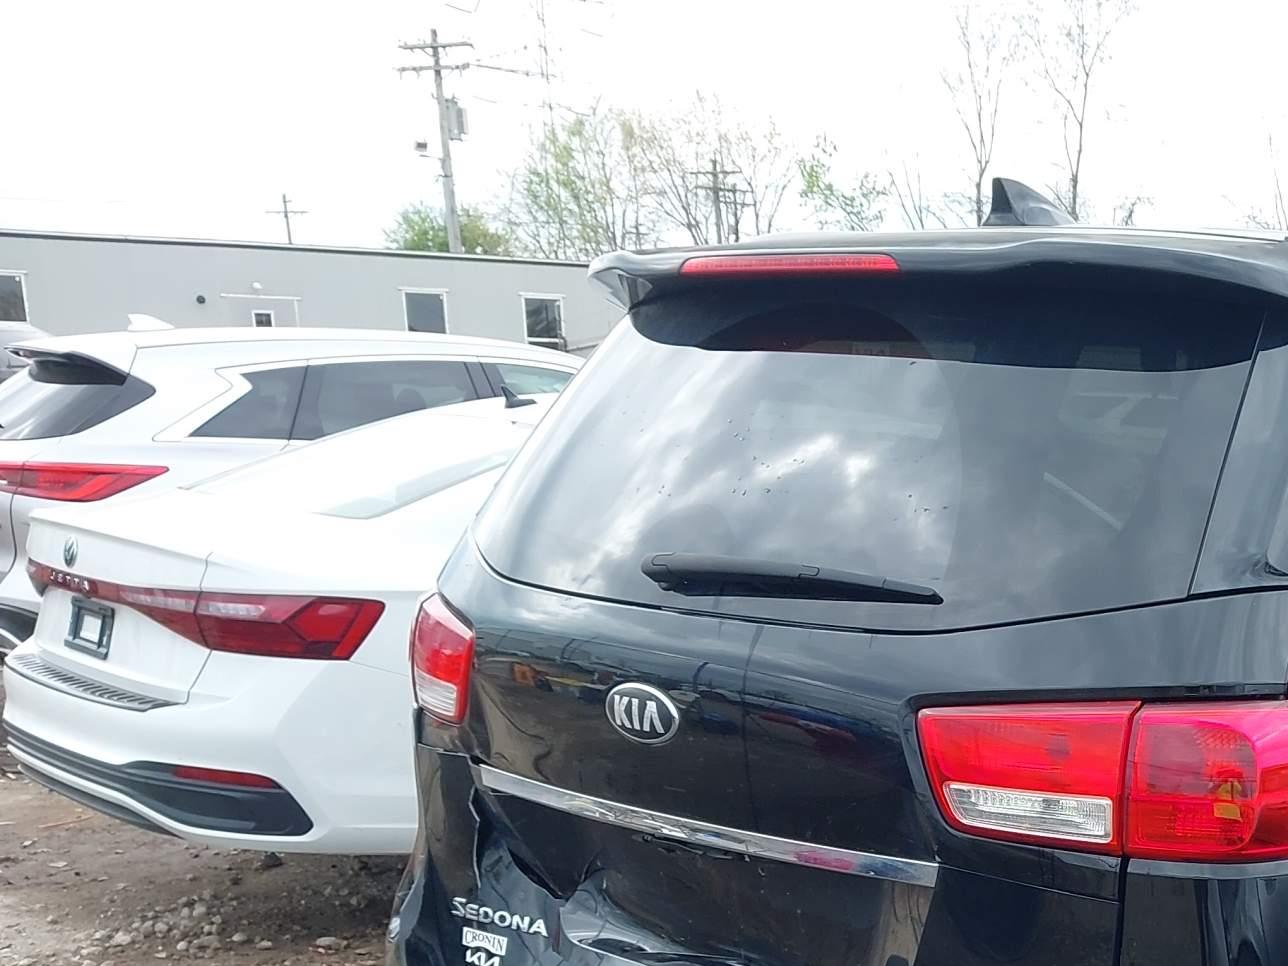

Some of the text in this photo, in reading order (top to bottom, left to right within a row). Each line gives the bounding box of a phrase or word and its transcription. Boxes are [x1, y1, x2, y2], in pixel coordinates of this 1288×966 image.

[612, 693, 666, 735] KIA
[450, 896, 549, 937] SEDONA
[464, 929, 506, 953] CRONIN
